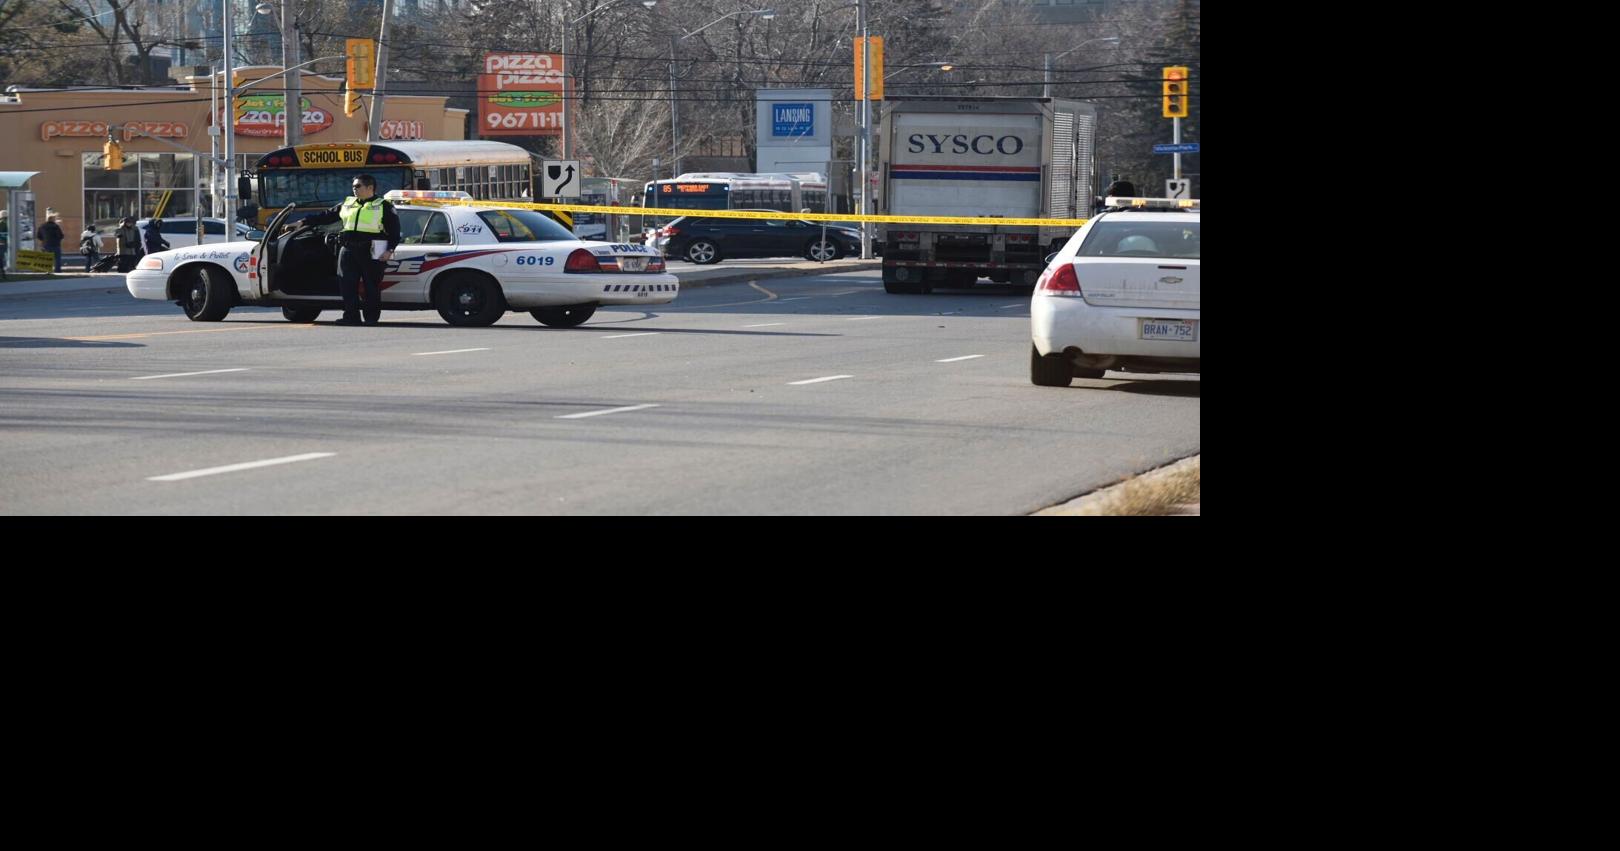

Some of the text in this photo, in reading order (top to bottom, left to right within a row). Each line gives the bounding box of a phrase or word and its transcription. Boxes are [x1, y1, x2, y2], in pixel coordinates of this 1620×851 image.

[487, 55, 553, 73] pizza
[496, 70, 563, 89] pizza
[487, 112, 527, 128] 967
[42, 121, 188, 141] pizza pizza
[908, 133, 1024, 155] SYSCO
[303, 150, 363, 163] SCHOOL BUS
[610, 244, 648, 254] POLICE
[516, 255, 555, 266] 6019
